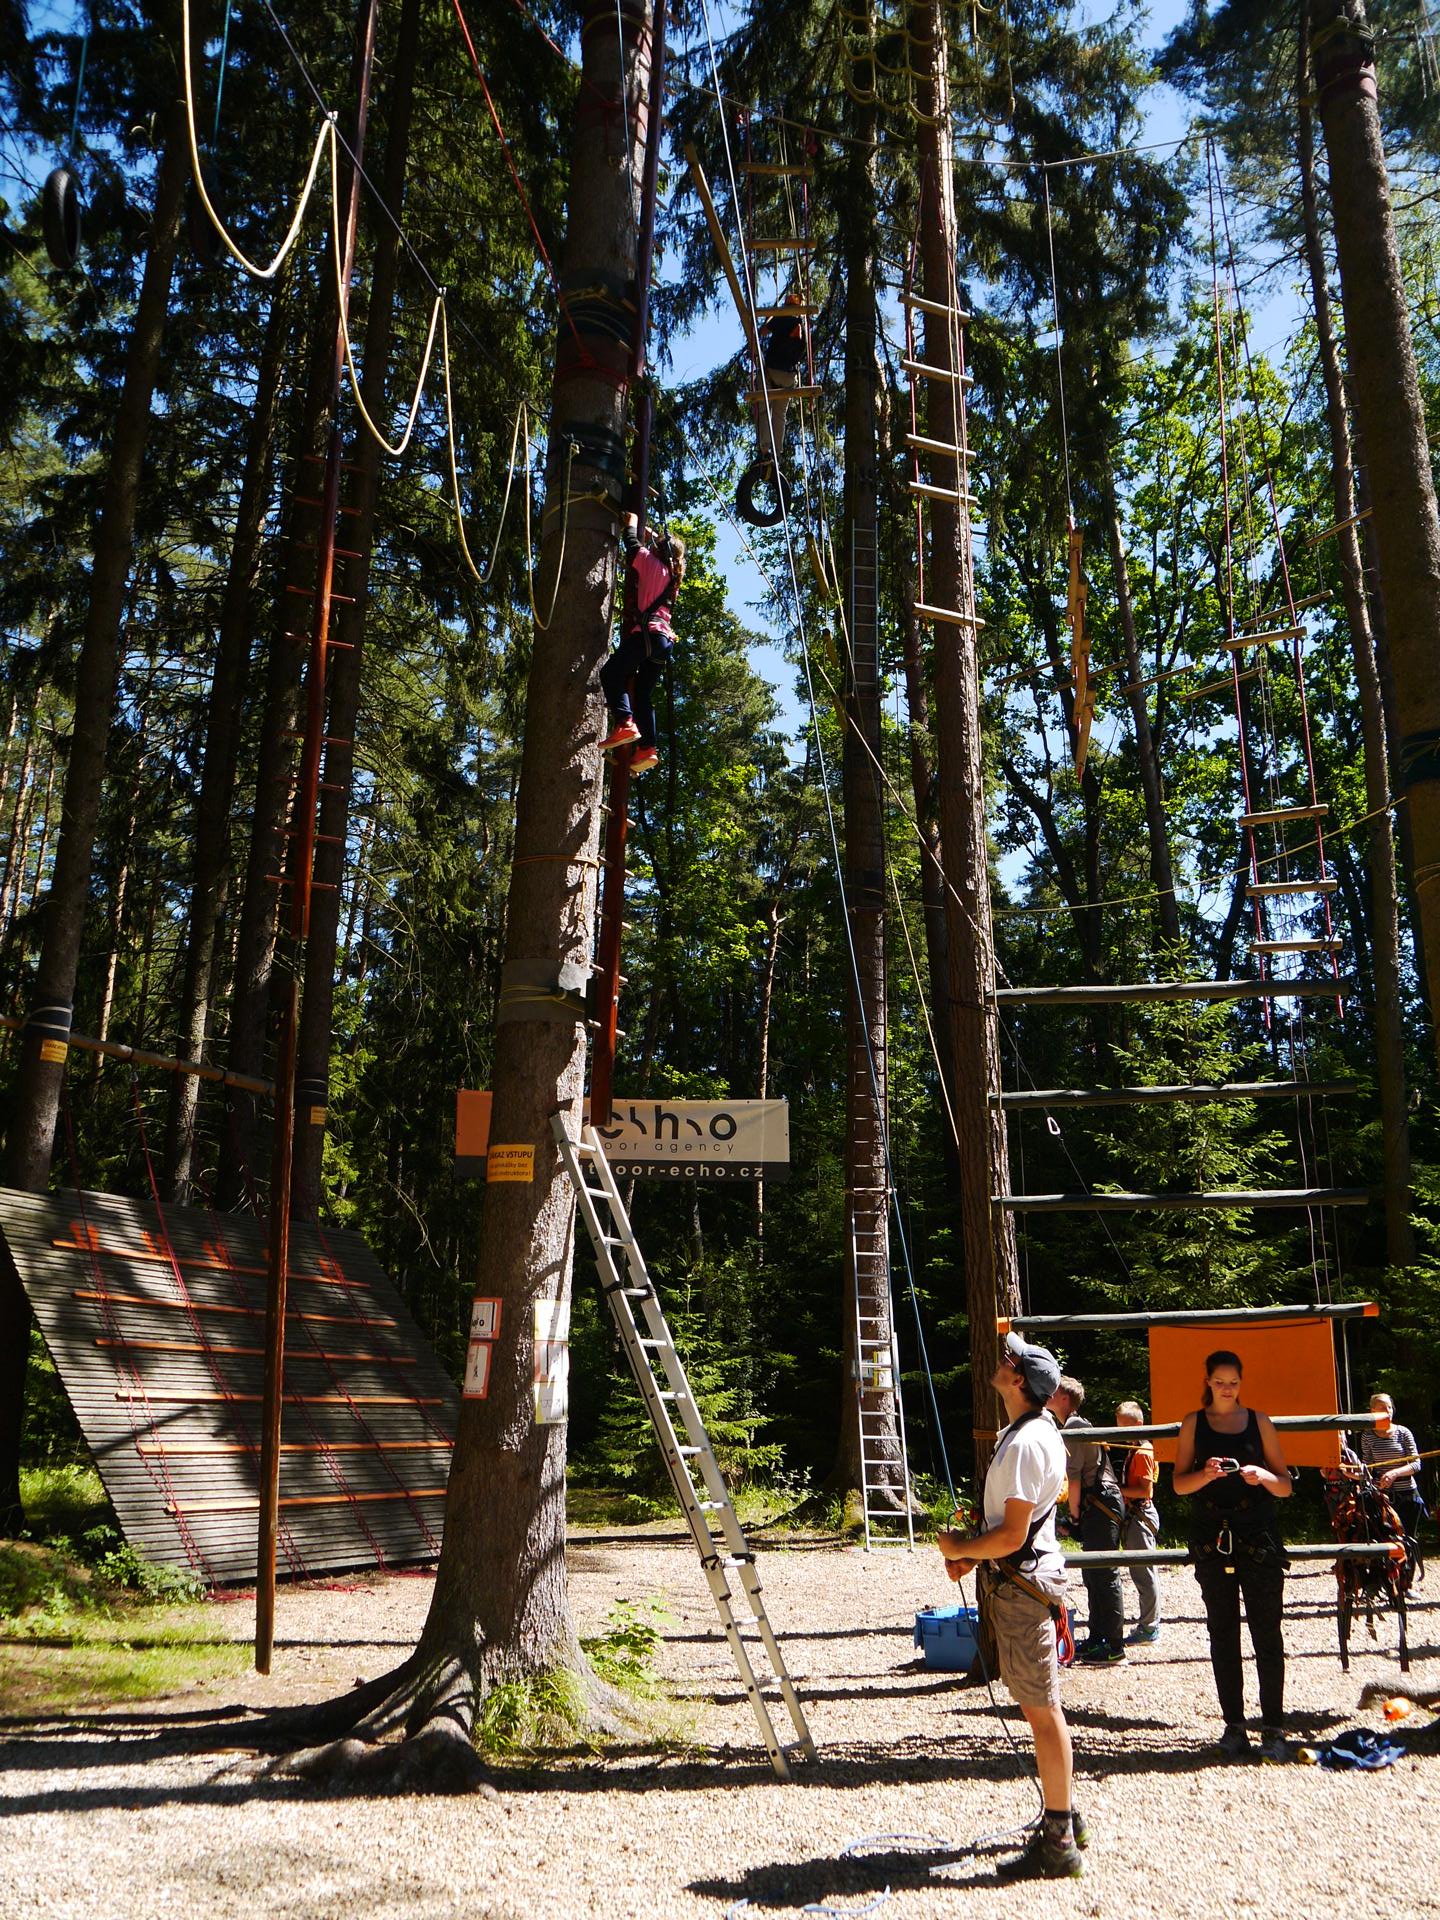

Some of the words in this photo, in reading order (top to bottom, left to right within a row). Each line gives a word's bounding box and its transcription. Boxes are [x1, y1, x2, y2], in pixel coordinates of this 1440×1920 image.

[582, 1105, 737, 1140] cho
[655, 1143, 734, 1154] agency
[504, 1150, 533, 1159] VSTUPU
